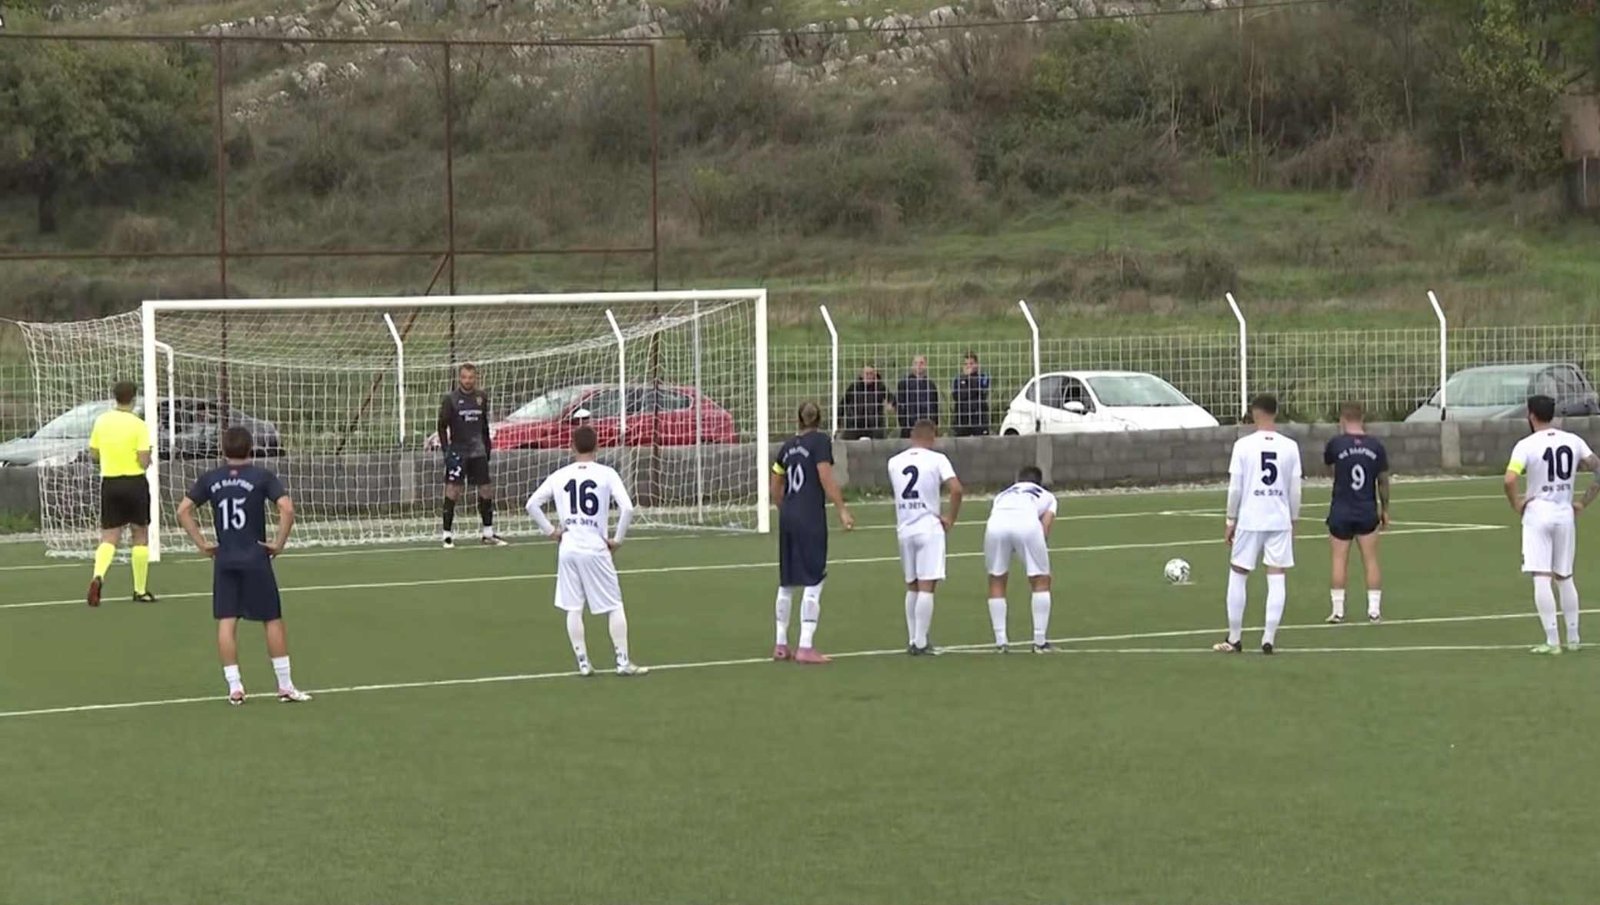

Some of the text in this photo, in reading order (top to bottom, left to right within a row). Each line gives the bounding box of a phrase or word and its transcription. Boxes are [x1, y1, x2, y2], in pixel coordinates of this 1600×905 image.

[787, 463, 804, 493] 10
[1260, 451, 1278, 486] 5
[1351, 464, 1365, 490] 9
[1542, 445, 1574, 482] 10
[563, 479, 599, 516] 16
[901, 465, 919, 500] 2
[218, 497, 246, 530] 15
